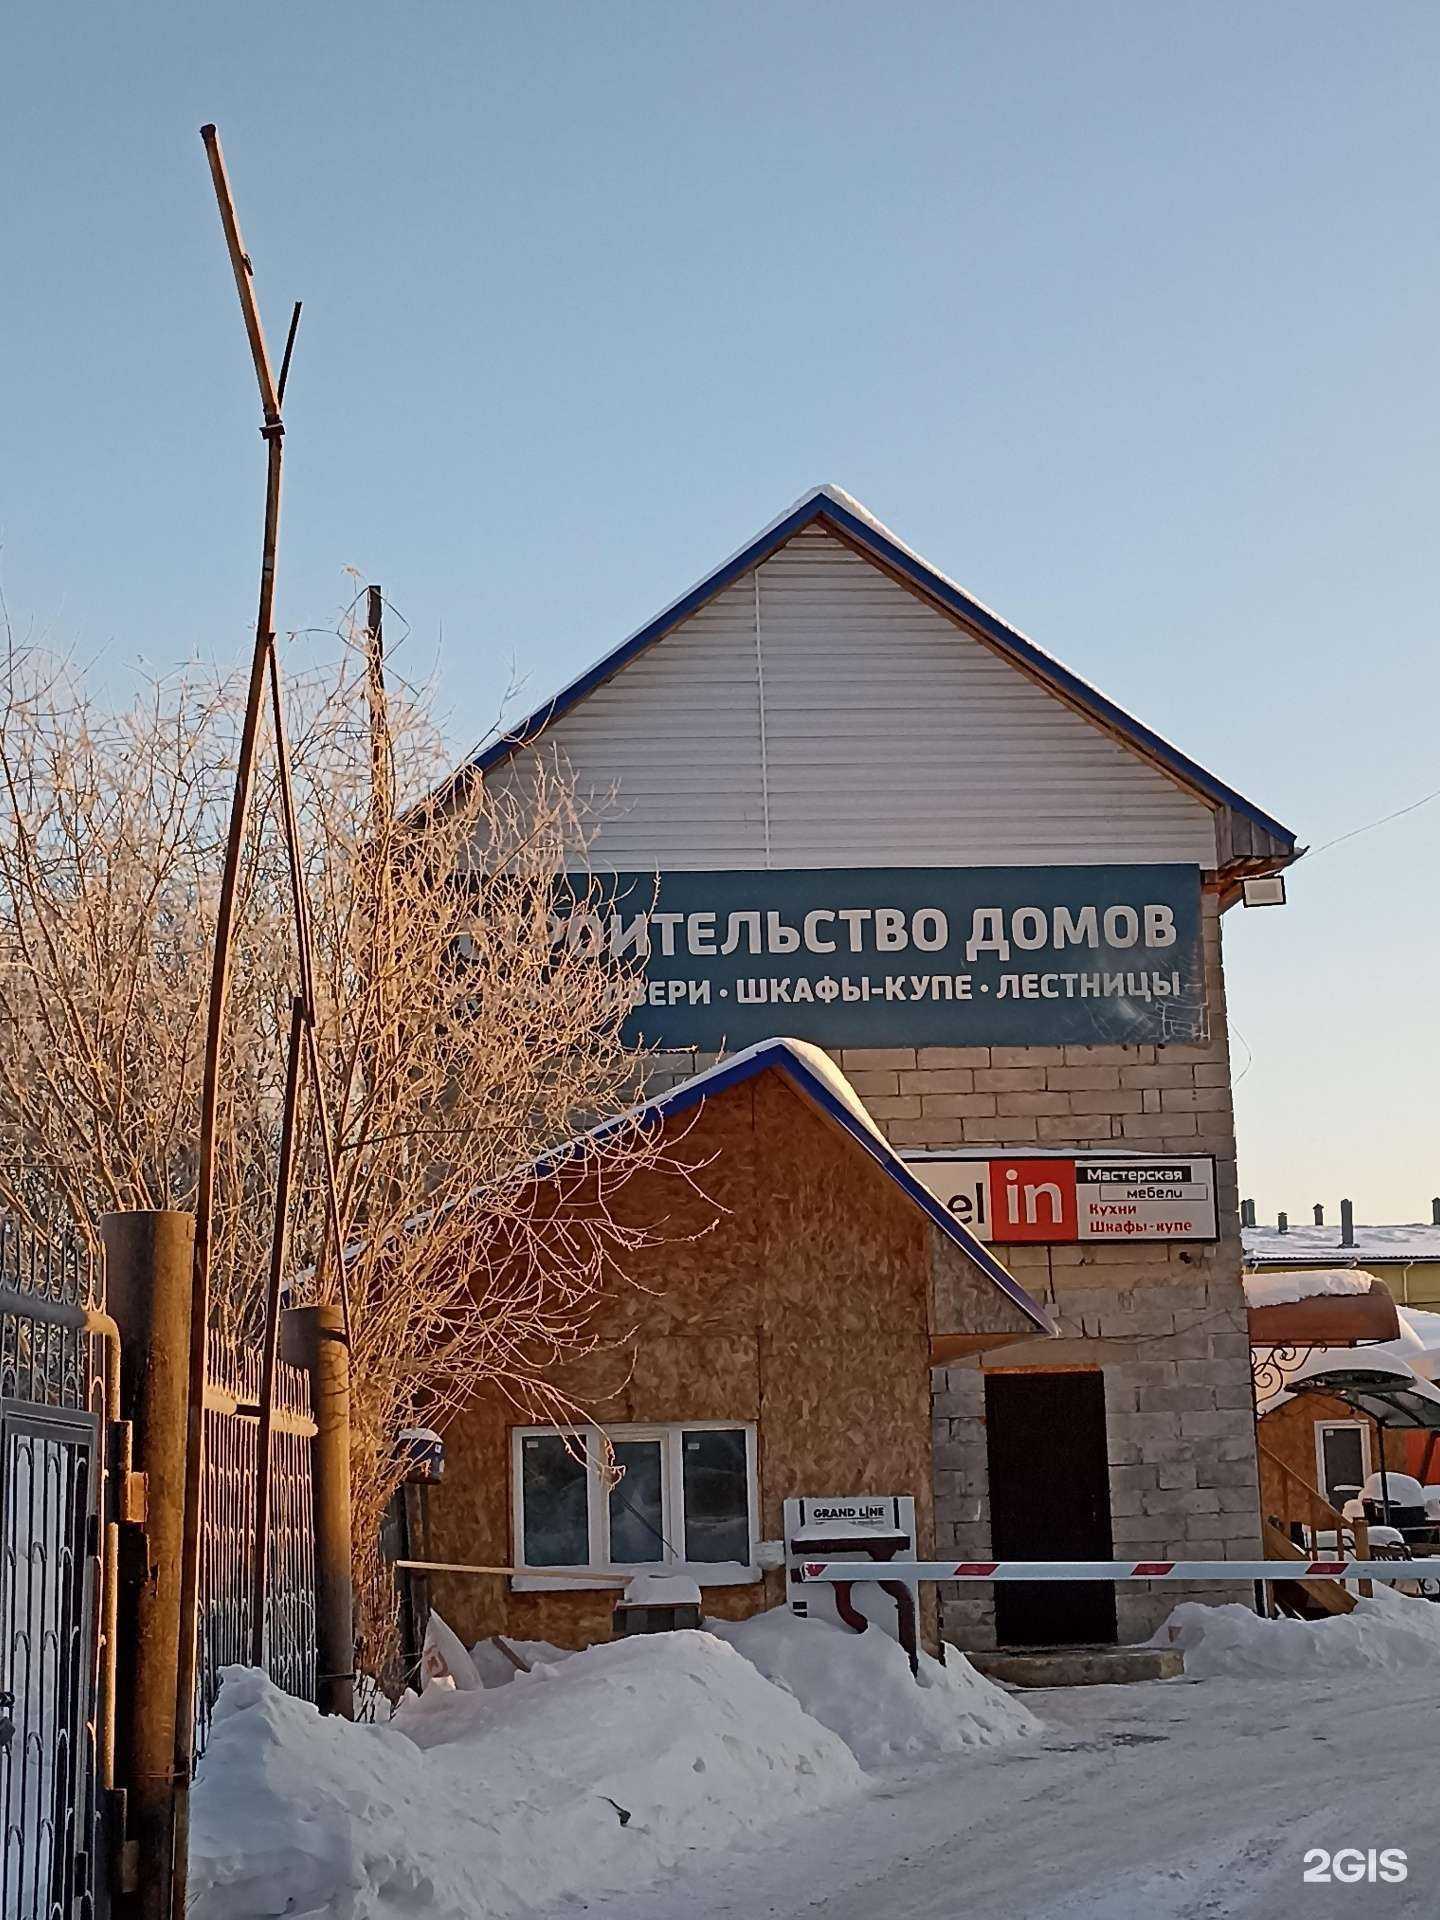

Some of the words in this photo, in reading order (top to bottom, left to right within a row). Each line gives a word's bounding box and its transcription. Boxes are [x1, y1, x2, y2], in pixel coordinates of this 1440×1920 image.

[966, 905, 1177, 961] ДОМОВ
[737, 975, 972, 1004] ШКАФЫ-КУПЕ
[997, 972, 1180, 1002] ЛЕСТНИЦЫ
[1087, 1168, 1183, 1184] Мастерская
[1127, 1187, 1183, 1199] мебели
[1089, 1203, 1137, 1216] Кухни
[813, 1507, 856, 1518] GRAND
[859, 1505, 885, 1519] LINE
